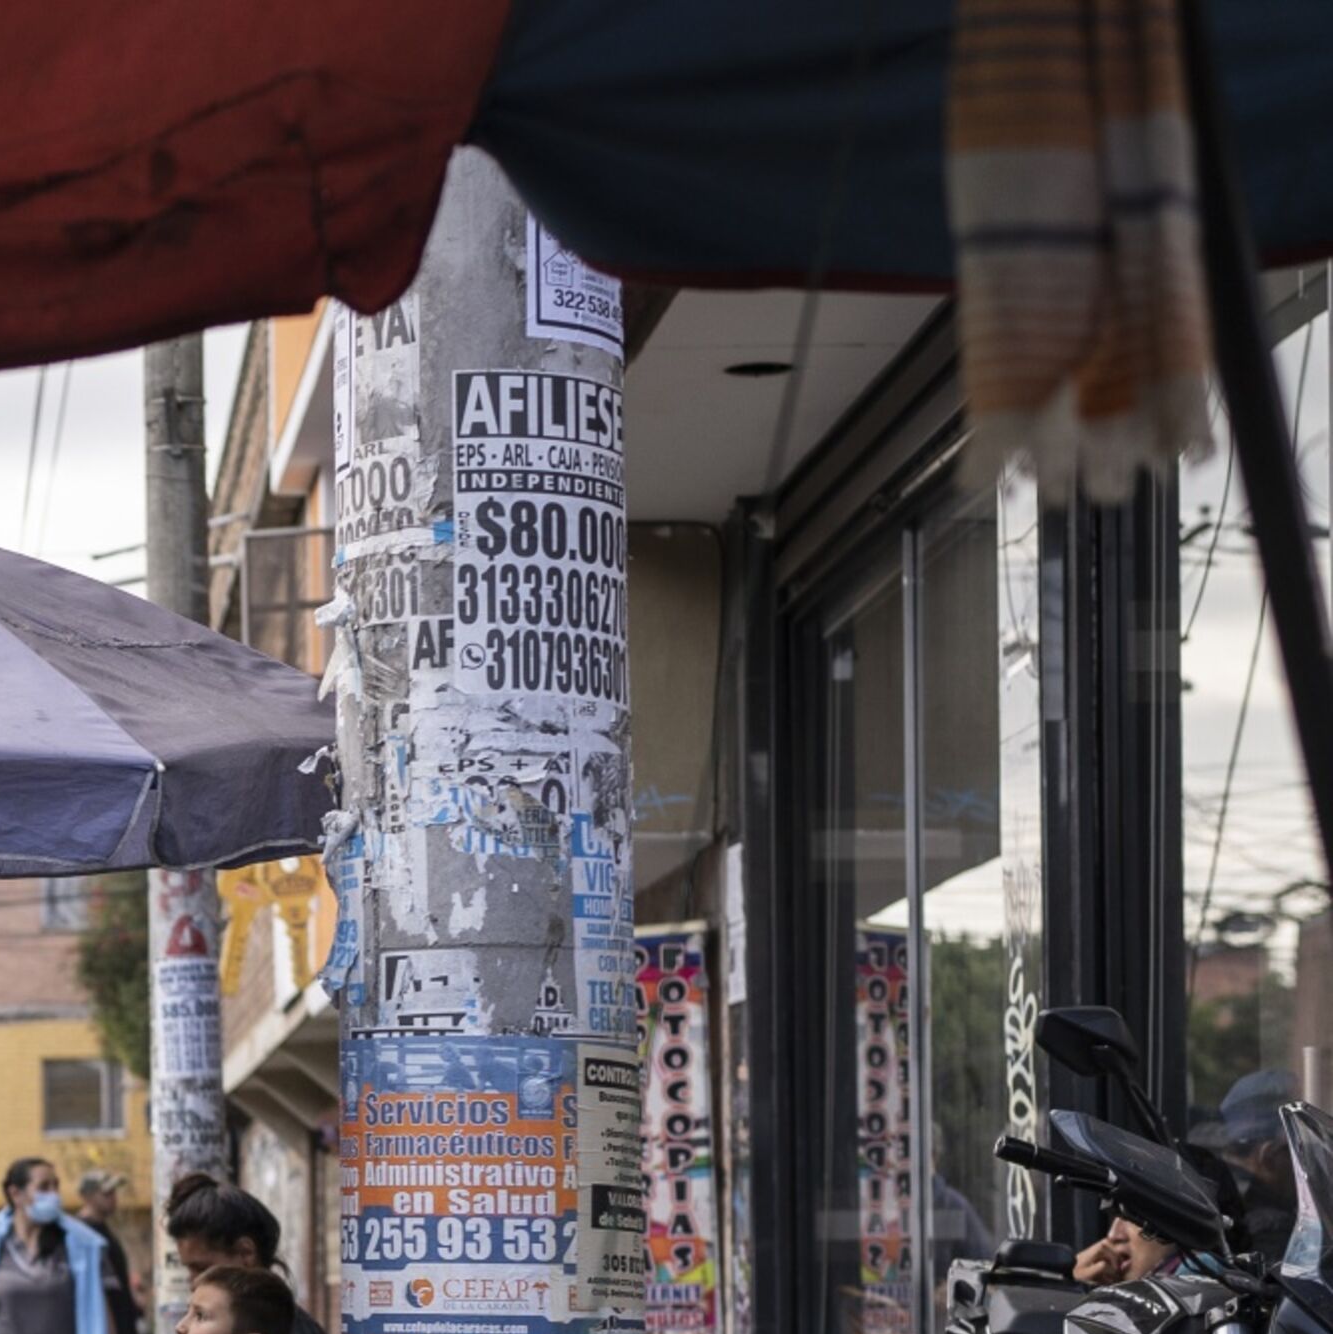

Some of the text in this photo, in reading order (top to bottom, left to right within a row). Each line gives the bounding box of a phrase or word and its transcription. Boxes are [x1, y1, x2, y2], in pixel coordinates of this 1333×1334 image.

[554, 288, 585, 311] 322
[459, 375, 624, 452] AFILIESE
[456, 443, 486, 466] EPS
[502, 444, 533, 466] ARL
[548, 446, 582, 472] CAJA
[475, 496, 625, 574] $80.000
[364, 1091, 510, 1127] Servicios
[364, 1130, 555, 1158] Farmacéuticos
[364, 1162, 556, 1187] Administrativo
[393, 1190, 557, 1217] en Salud
[364, 1217, 428, 1261] 255
[437, 1217, 492, 1262] 93
[503, 1219, 558, 1263] 53
[442, 1279, 529, 1299] CEFAP
